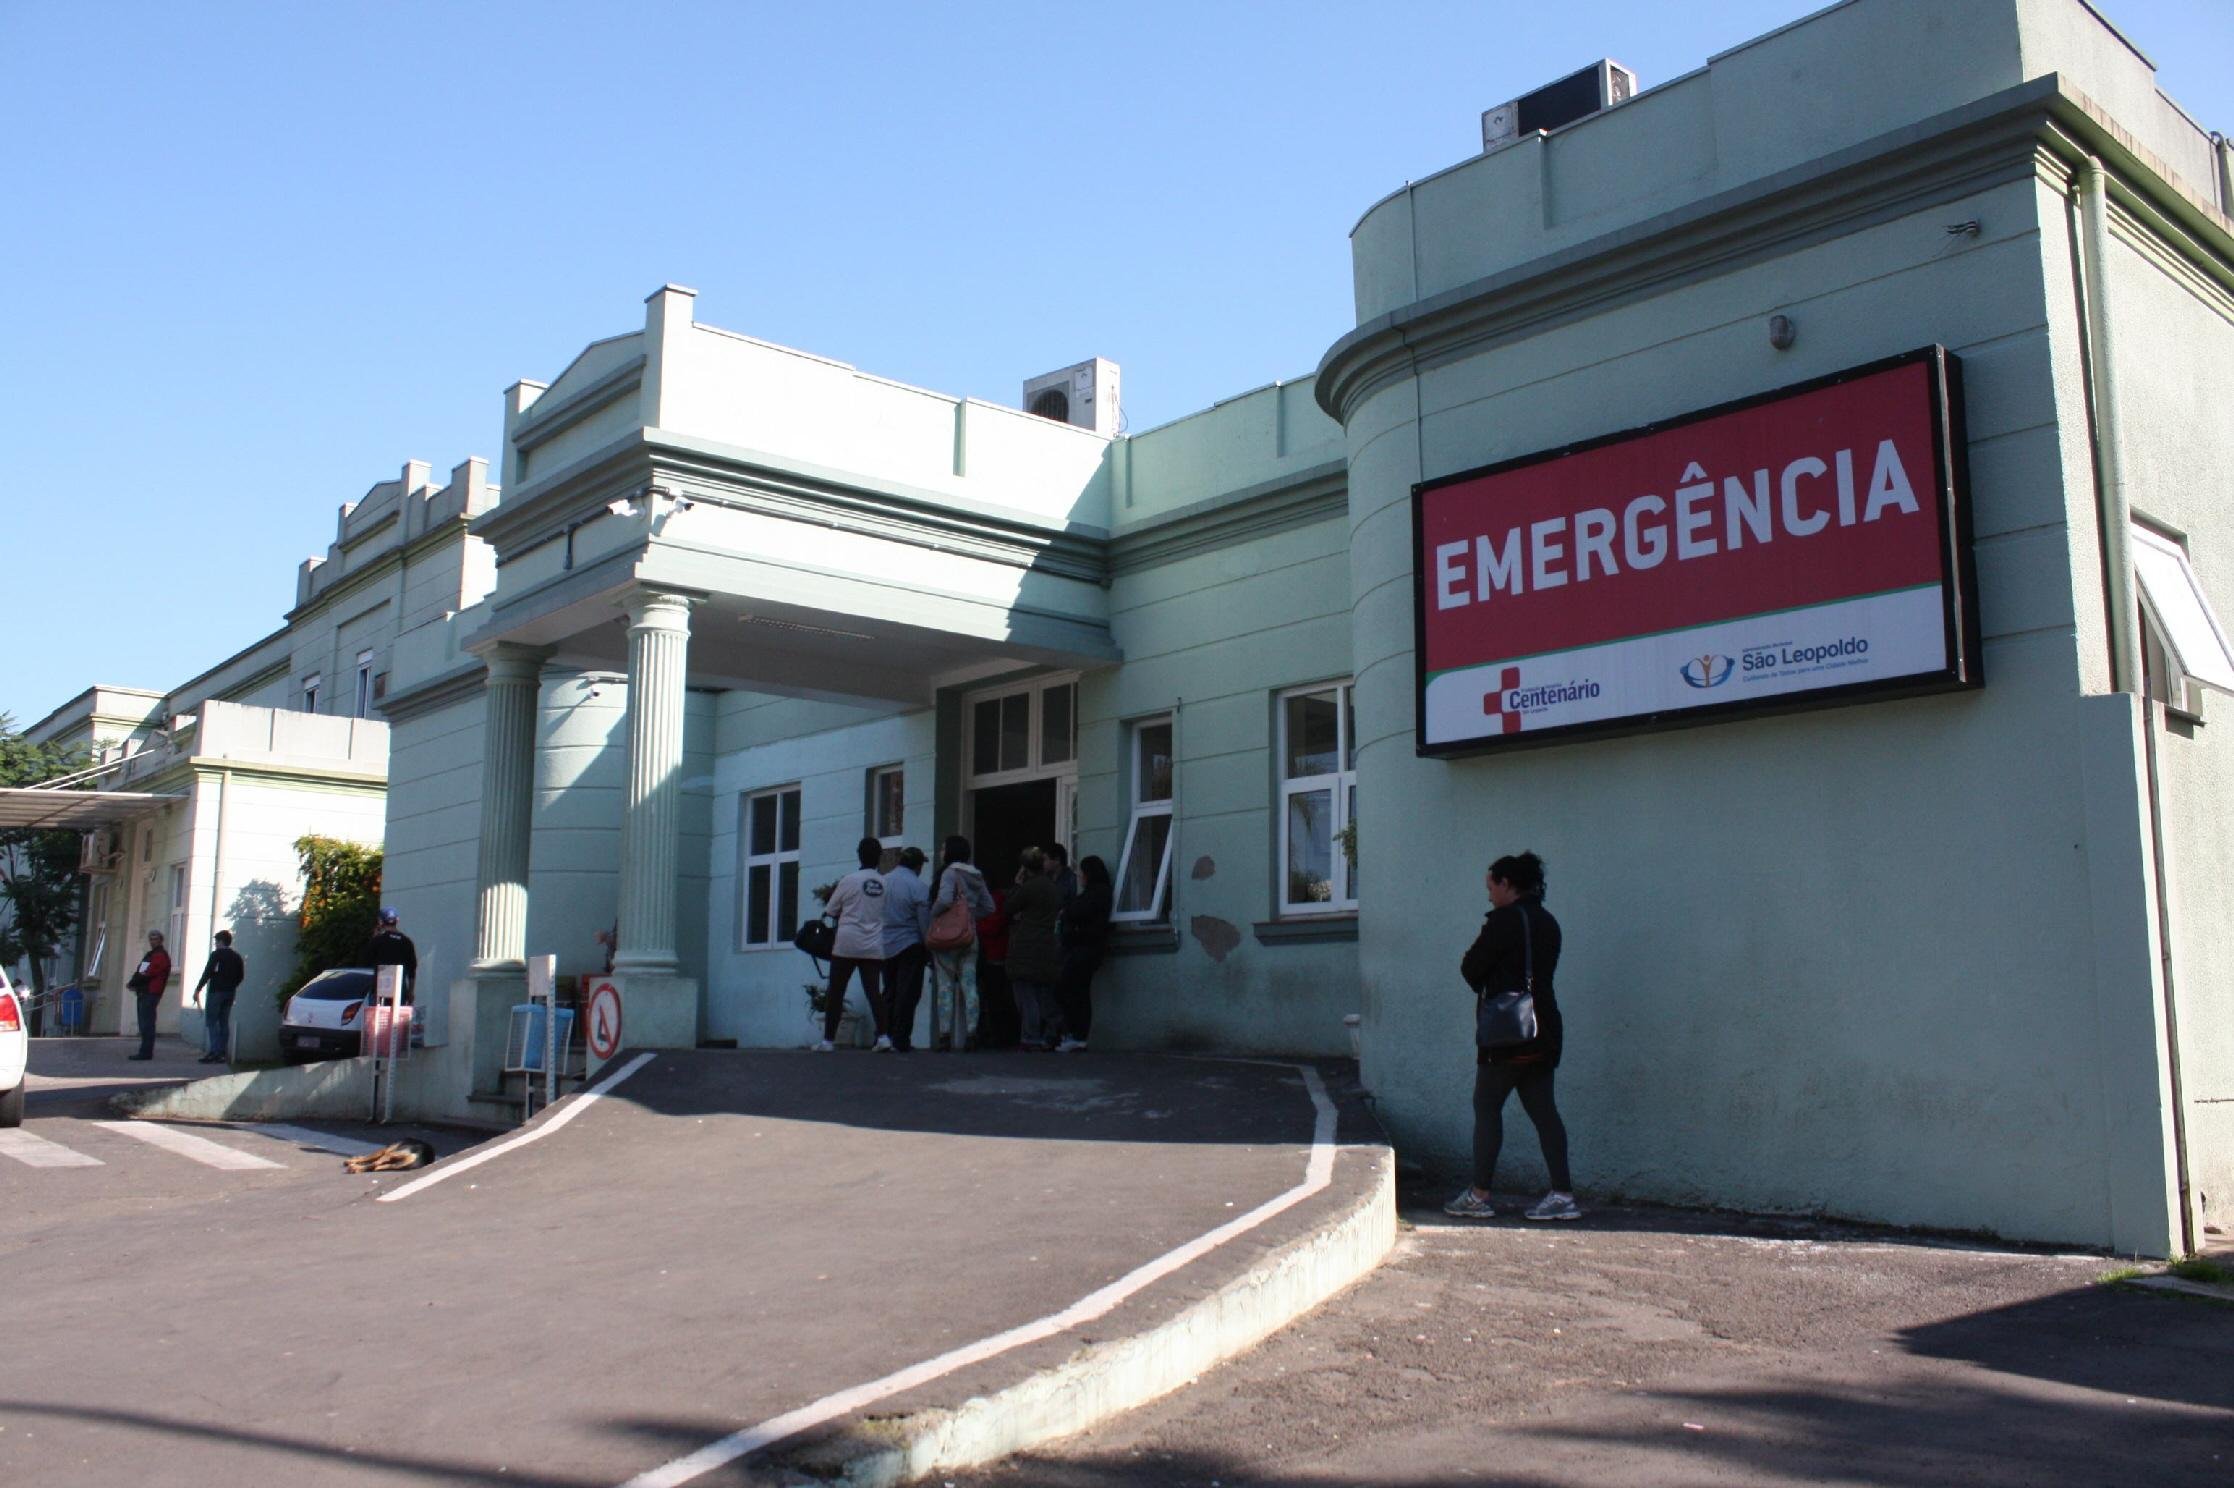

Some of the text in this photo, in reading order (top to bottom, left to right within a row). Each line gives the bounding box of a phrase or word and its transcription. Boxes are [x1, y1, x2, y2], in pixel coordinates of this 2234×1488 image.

[1436, 438, 1920, 612] EMERGÊNCIA
[1742, 651, 1777, 671] São
[1782, 636, 1868, 664] Leopoldo
[1509, 678, 1600, 710] Centenário
